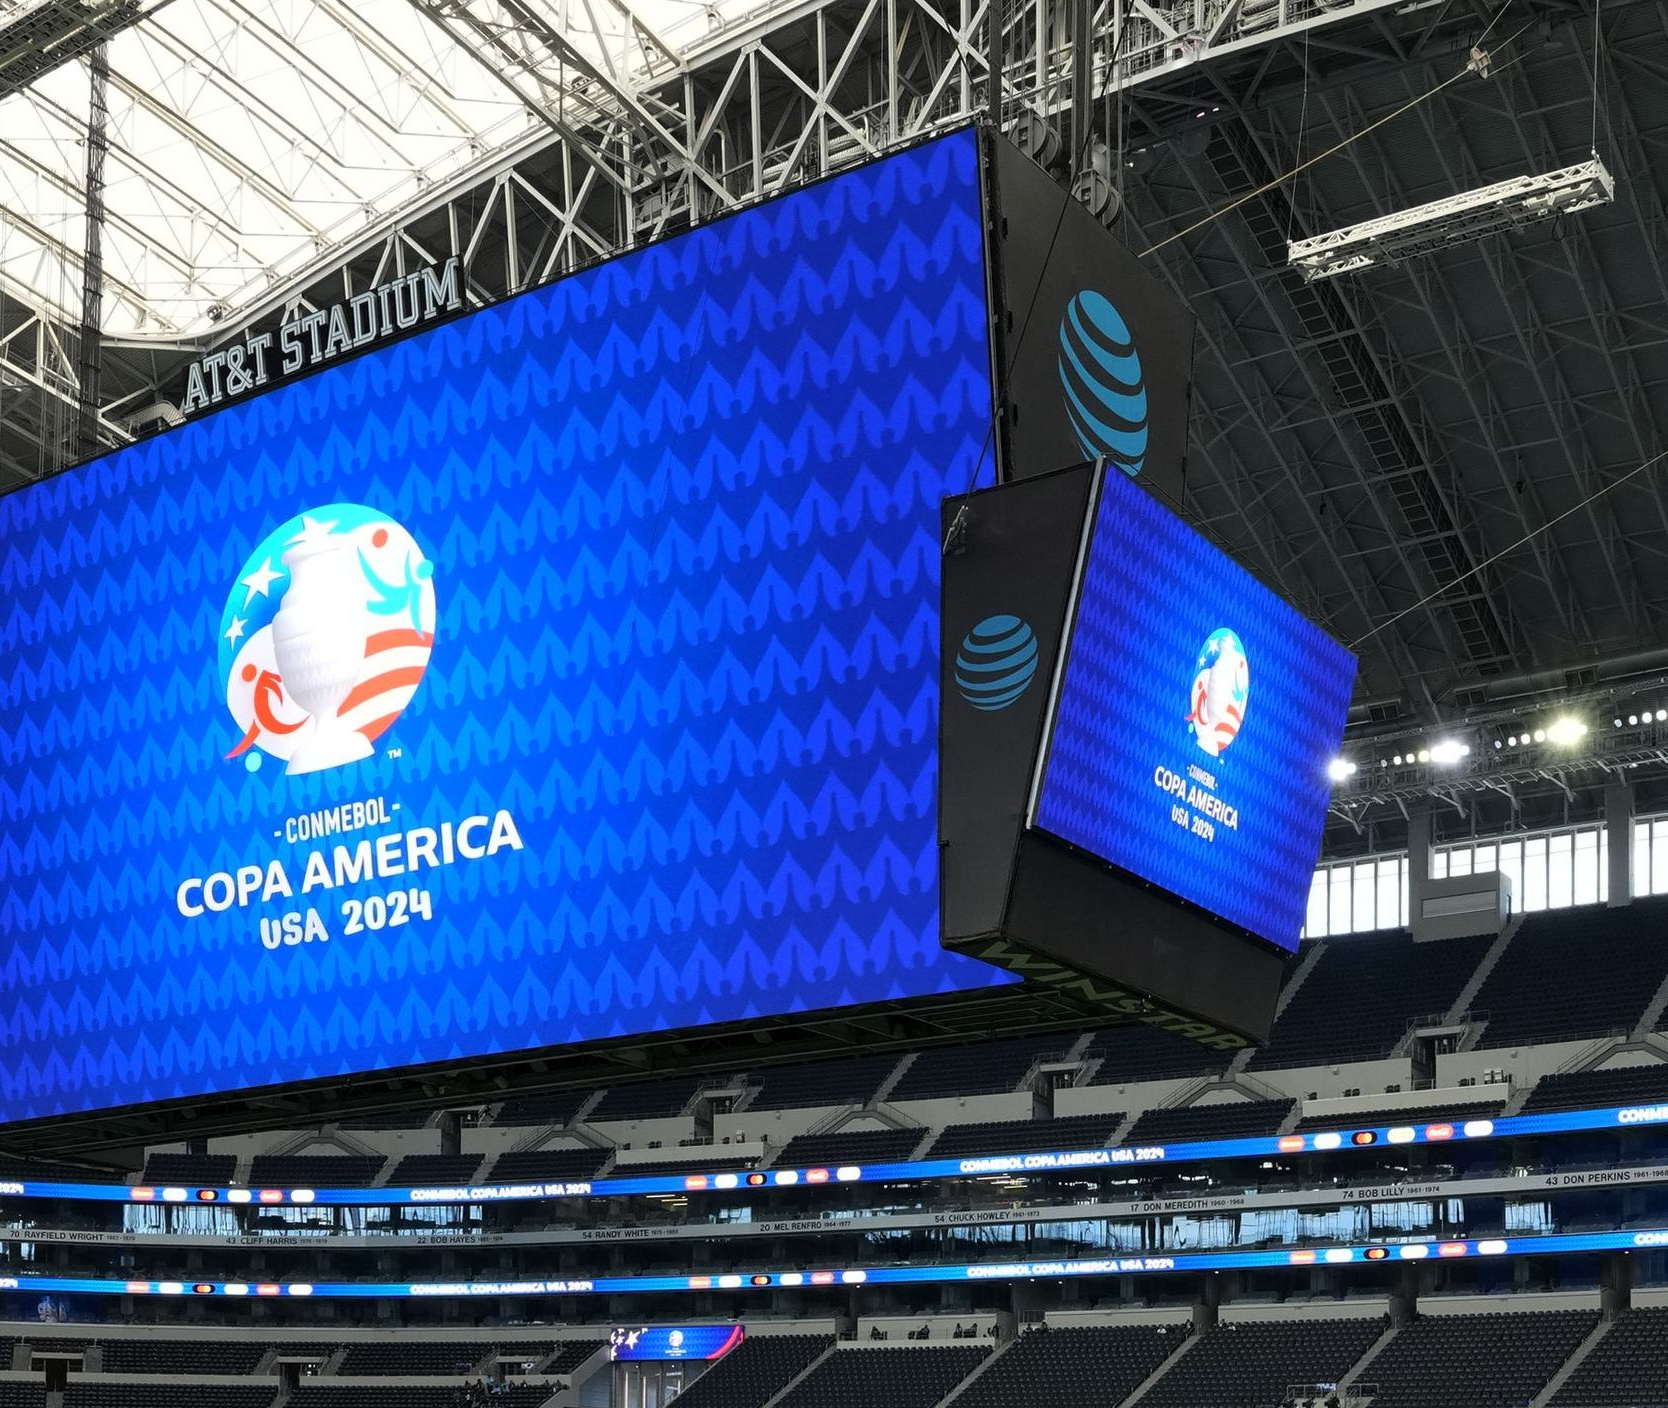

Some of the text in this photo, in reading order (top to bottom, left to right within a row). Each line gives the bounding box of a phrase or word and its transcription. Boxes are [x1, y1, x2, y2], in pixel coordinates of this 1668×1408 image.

[184, 256, 462, 413] AT&T STADIUM
[1154, 765, 1238, 831] COPA AMERICA
[1172, 804, 1215, 842] USA 2024
[176, 809, 524, 918] COPA AMERICA
[260, 888, 432, 950] USA 2024
[979, 941, 1248, 1050] WINSTAR
[1342, 1186, 1405, 1200] 74 BOB LILLY
[1544, 1175, 1558, 1186] 43
[1563, 1174, 1584, 1185] DON
[1587, 1170, 1630, 1183] PERKINS
[1130, 1199, 1208, 1213] 17 DON MEREDITH
[9, 1229, 104, 1241] 70 RAYFIELD WRIGHT
